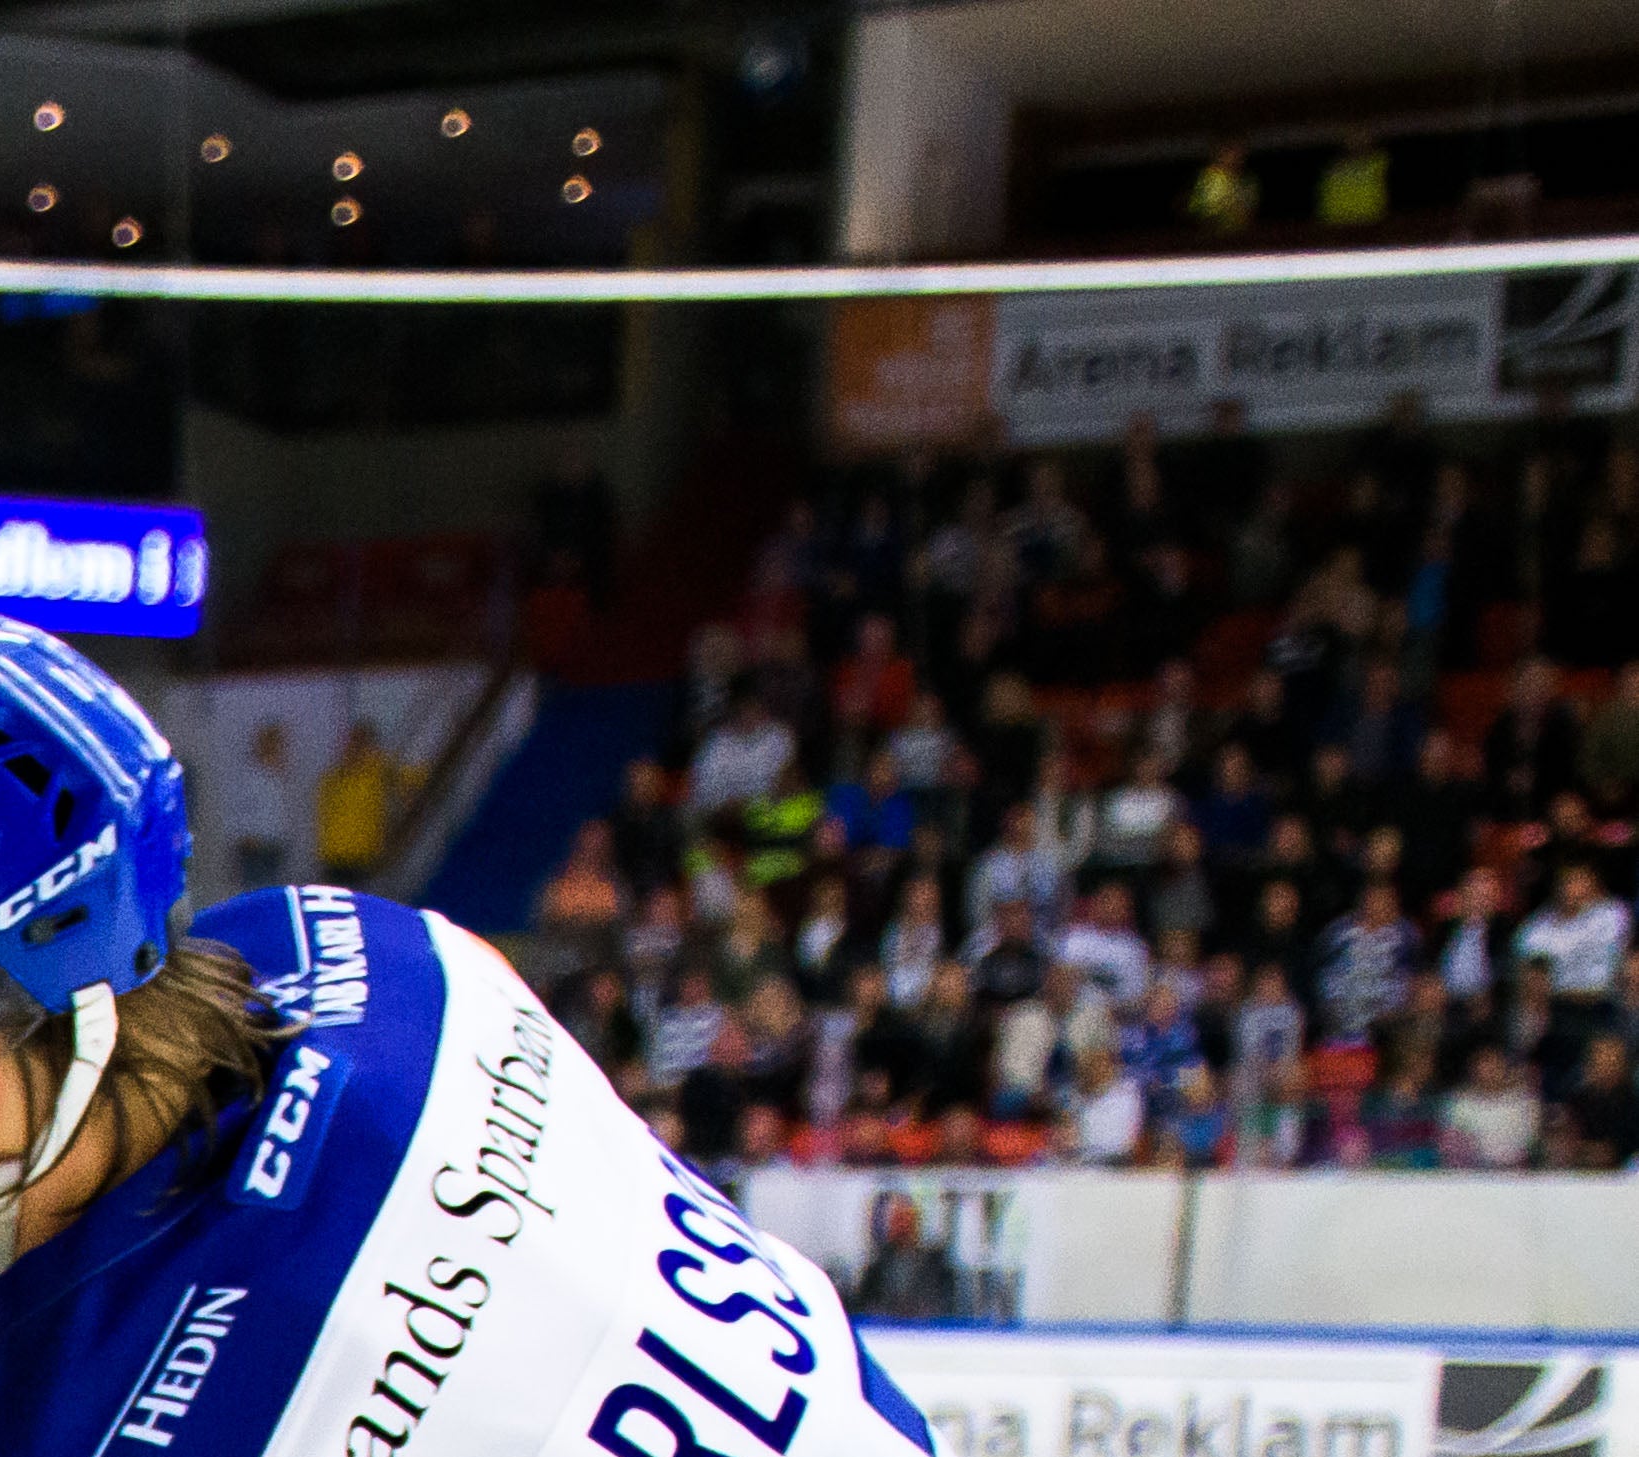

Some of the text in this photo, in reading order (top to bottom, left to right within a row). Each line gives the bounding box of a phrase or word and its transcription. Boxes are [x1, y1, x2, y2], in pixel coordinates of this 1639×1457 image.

[1222, 314, 1481, 373] Reklam
[242, 1046, 332, 1200] CCM
[132, 1284, 251, 1450] HEDIN
